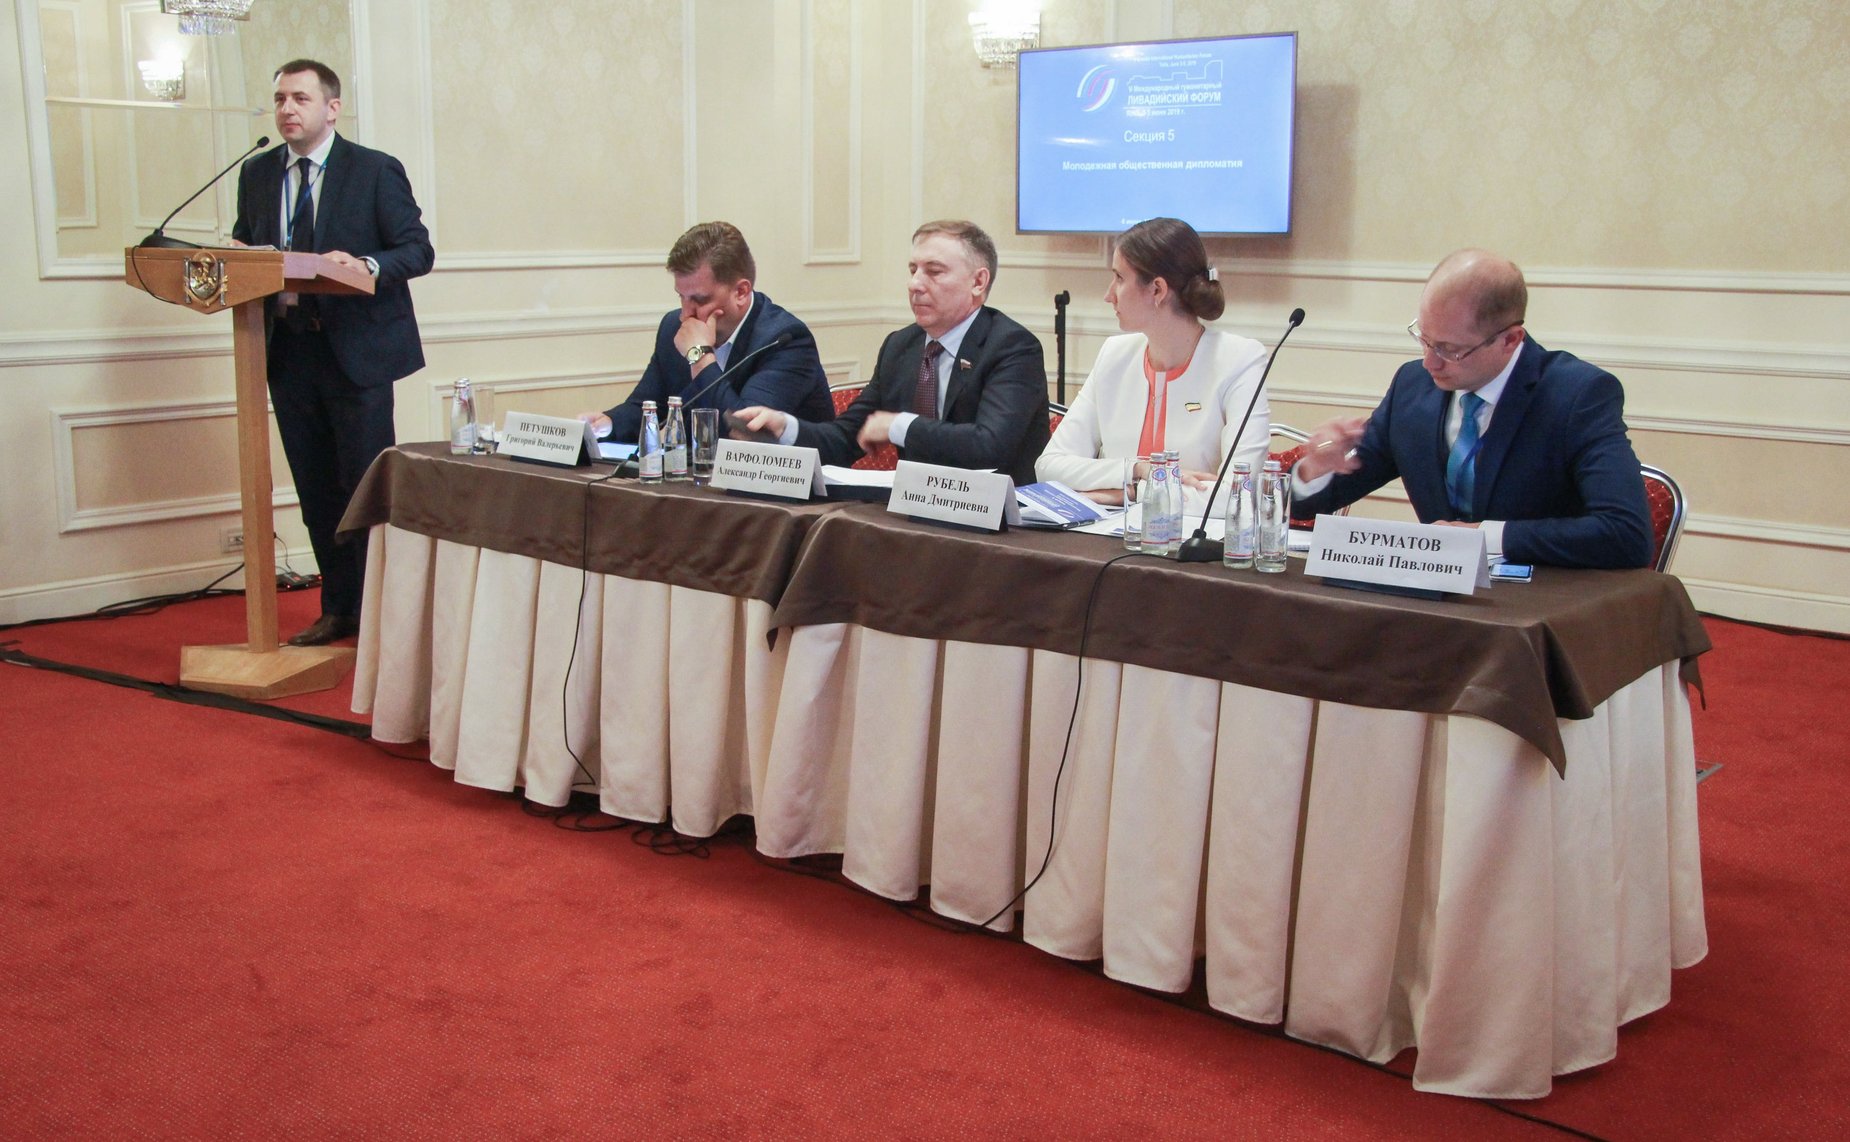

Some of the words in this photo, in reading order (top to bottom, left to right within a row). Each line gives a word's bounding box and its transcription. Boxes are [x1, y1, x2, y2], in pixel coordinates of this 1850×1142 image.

[1128, 91, 1189, 105] ЛИВАДИЙСКИЙ
[1190, 91, 1222, 104] ФОРУМ
[1123, 129, 1165, 144] Секция
[1167, 129, 1175, 141] 5
[1062, 160, 1117, 172] Молодежная
[1118, 159, 1184, 171] общественная
[1185, 159, 1243, 170] дипломатия
[519, 422, 567, 437] ПЕТУШКОВ
[505, 434, 536, 447] Григорий
[536, 438, 575, 452] Валерьевич
[725, 451, 802, 470] ВАРФОЛОМЕЕВ
[717, 466, 757, 481] Александр
[758, 470, 806, 485] Георгиевич
[926, 475, 970, 493] РУБЕЛЬ
[901, 490, 926, 503] Анна
[927, 494, 989, 514] Дмитриевна
[1348, 530, 1442, 552] БУРМАТОВ
[1320, 548, 1384, 567] Николай
[1388, 555, 1463, 575] Павлович
